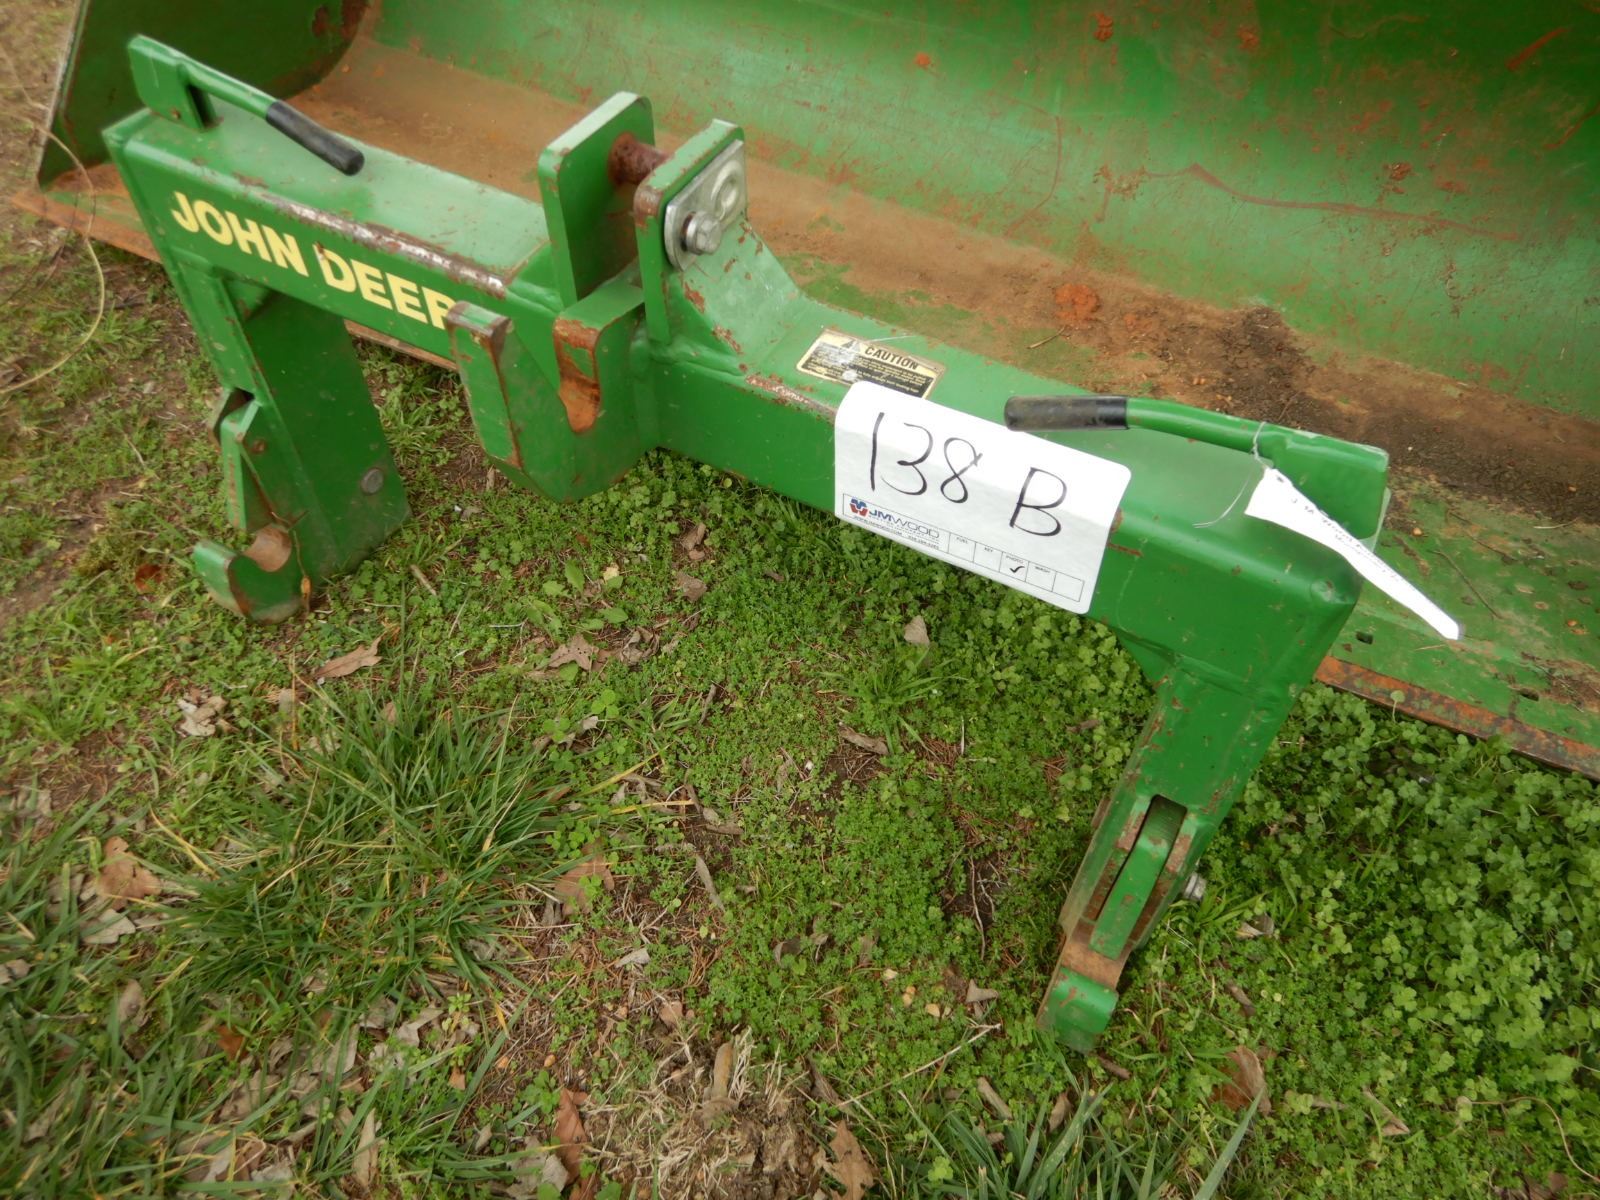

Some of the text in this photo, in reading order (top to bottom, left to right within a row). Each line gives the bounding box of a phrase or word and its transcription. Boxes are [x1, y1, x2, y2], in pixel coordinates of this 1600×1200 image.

[170, 191, 459, 330] JOHN DEER
[864, 346, 919, 371] CAUTION
[869, 411, 1068, 537] 138 B
[869, 509, 940, 539] JMWOOD
